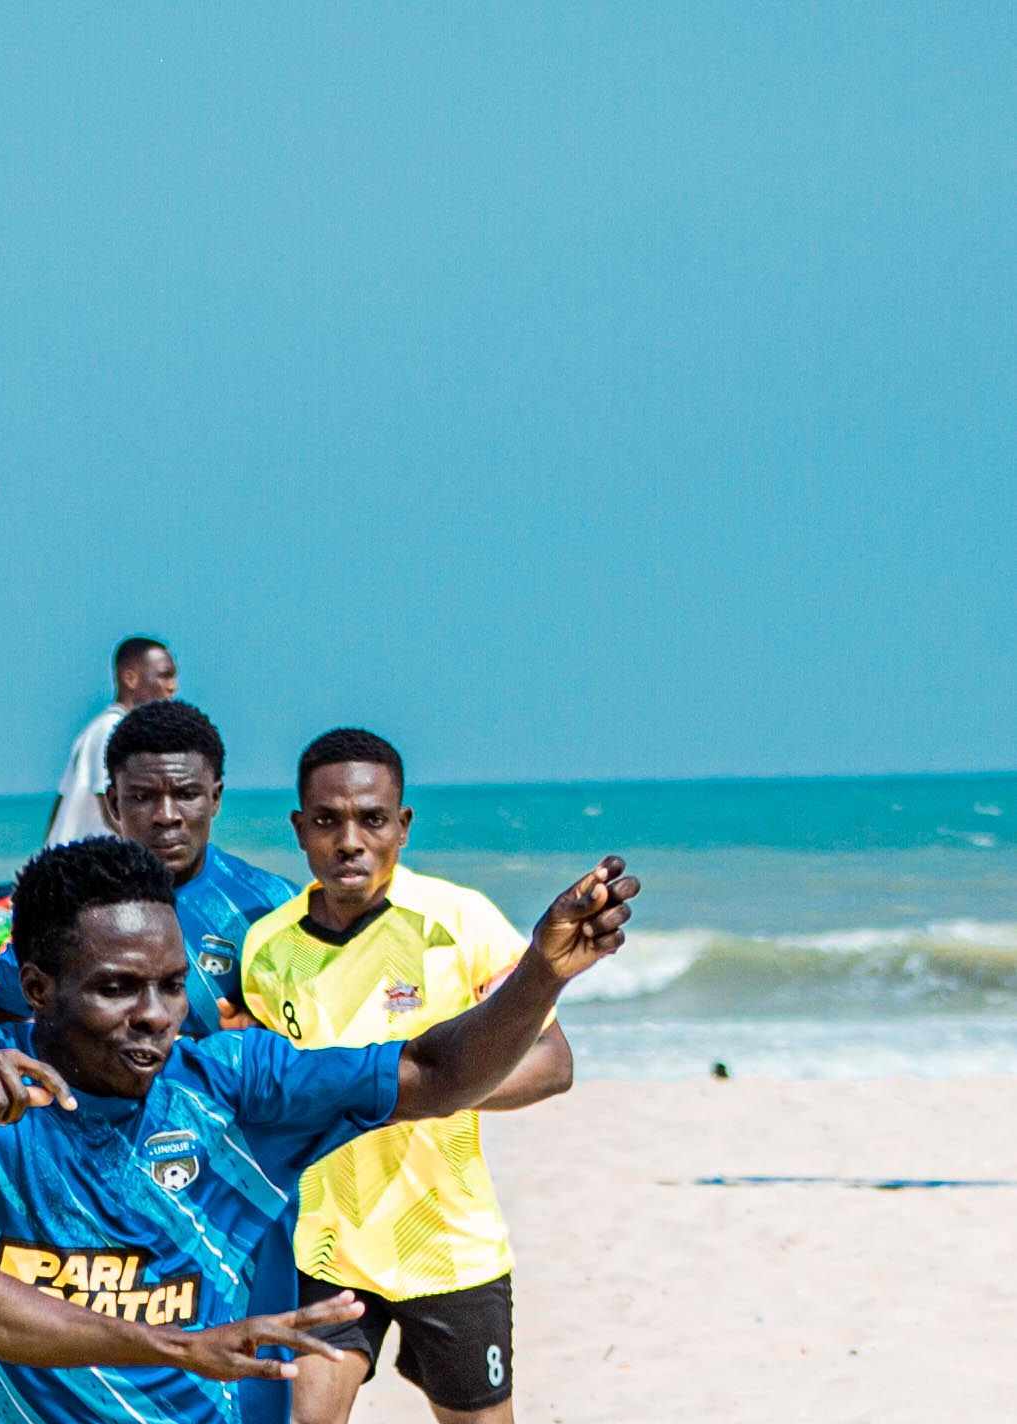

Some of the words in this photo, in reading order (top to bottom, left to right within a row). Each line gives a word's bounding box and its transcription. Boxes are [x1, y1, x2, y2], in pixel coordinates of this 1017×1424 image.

[283, 1001, 302, 1040] 8
[153, 1142, 190, 1156] UNIQUE
[0, 1246, 139, 1292] PARI
[486, 1345, 504, 1387] 8
